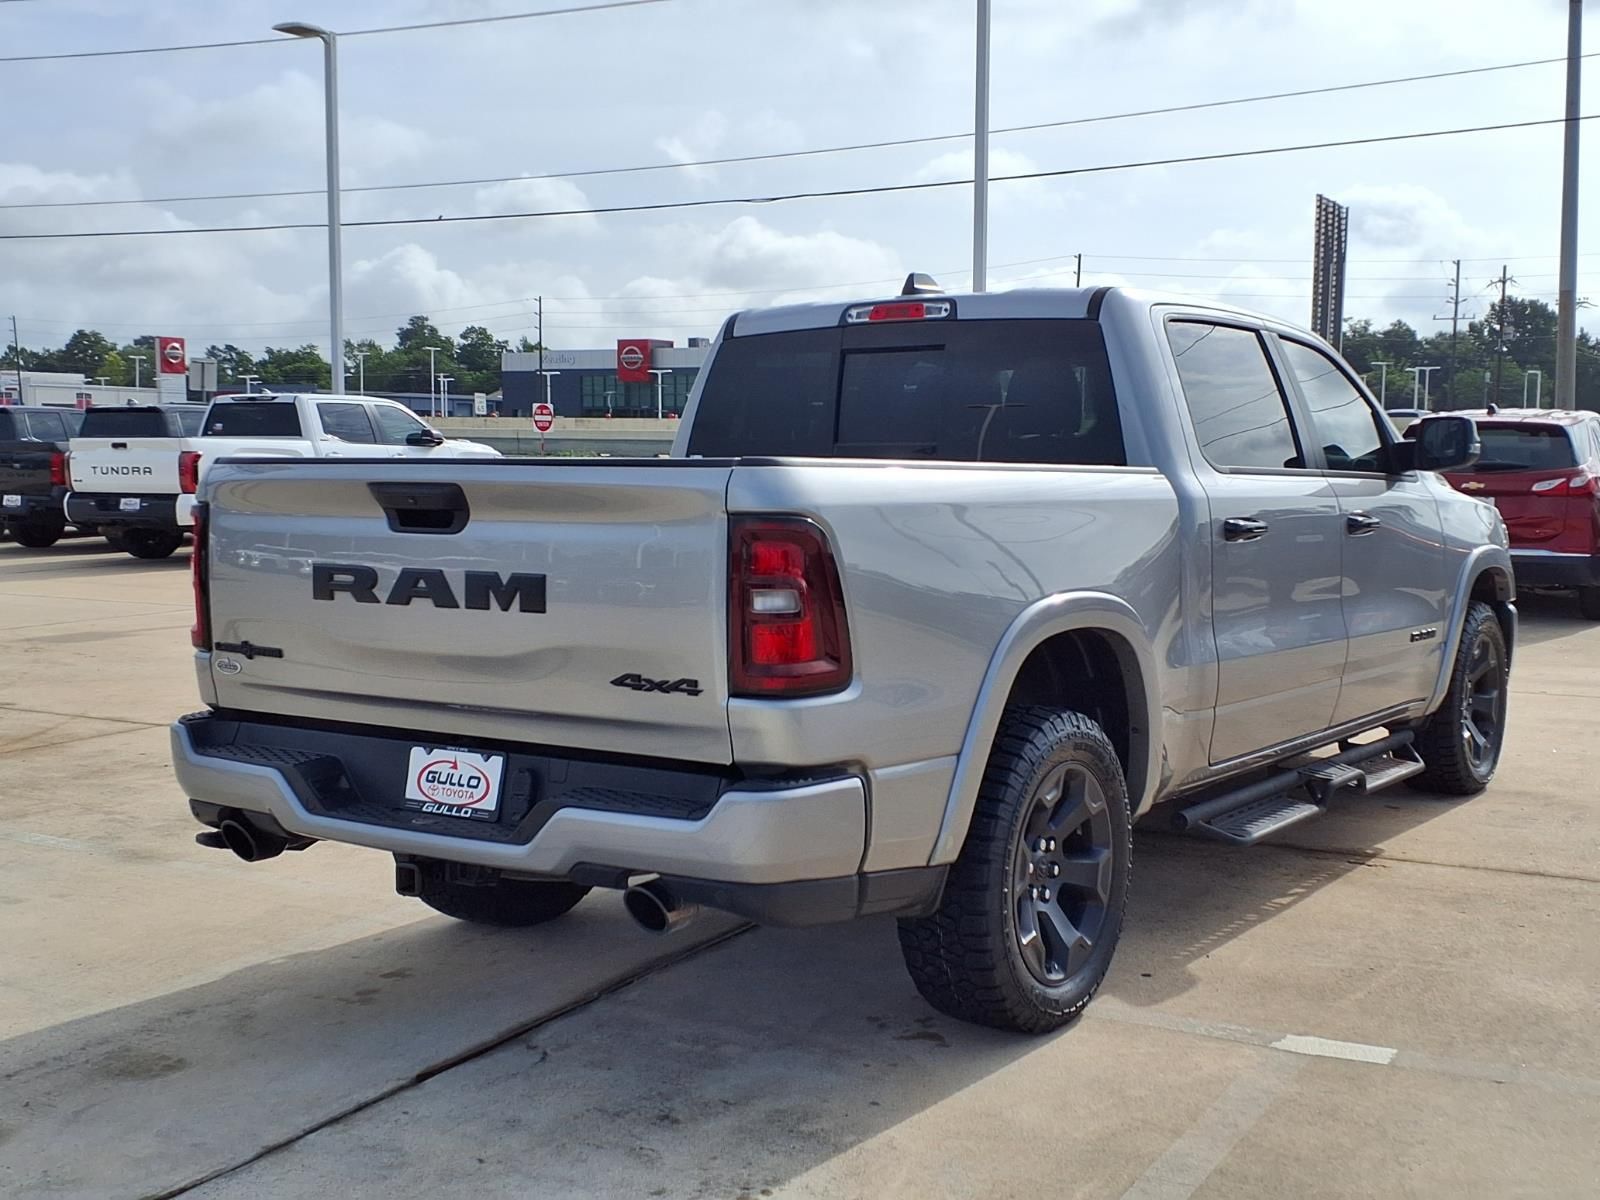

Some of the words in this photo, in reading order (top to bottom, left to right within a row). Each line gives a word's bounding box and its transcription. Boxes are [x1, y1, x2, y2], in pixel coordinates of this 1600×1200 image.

[91, 466, 152, 476] TUNDRA
[312, 563, 547, 614] RAM
[425, 769, 481, 790] GULLO
[441, 787, 475, 801] TOYOTA
[422, 803, 472, 818] GULLO
